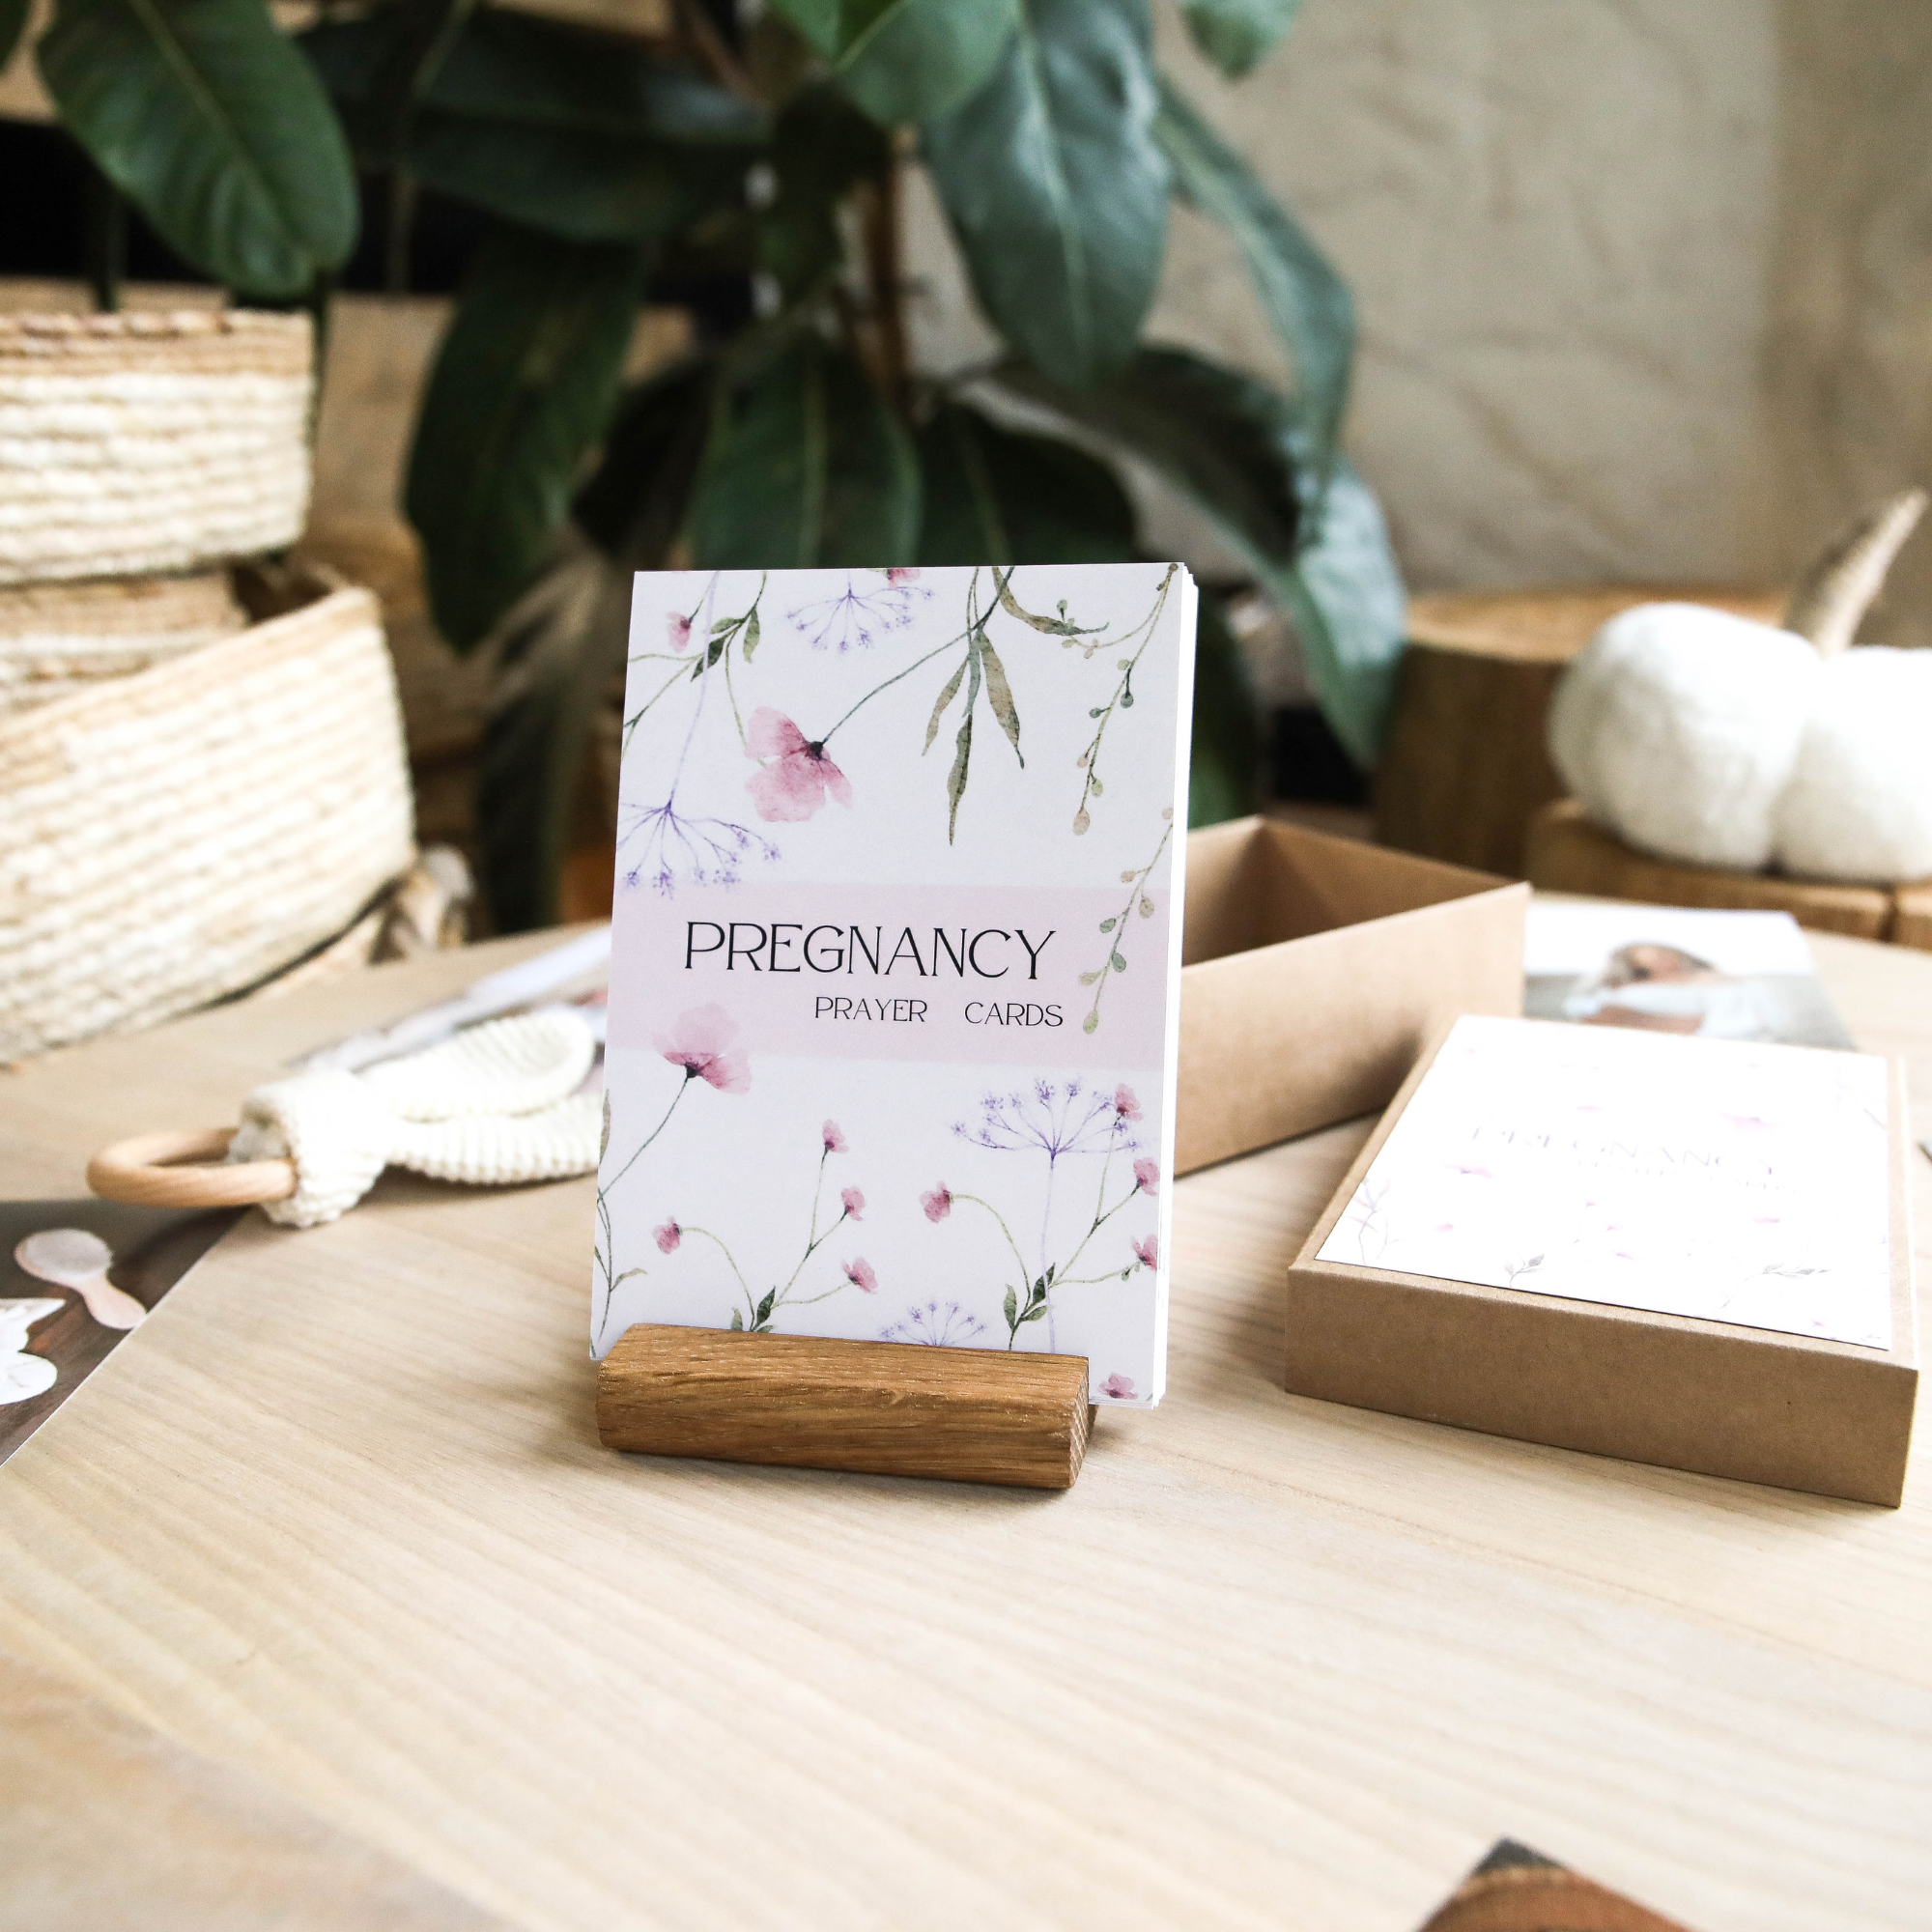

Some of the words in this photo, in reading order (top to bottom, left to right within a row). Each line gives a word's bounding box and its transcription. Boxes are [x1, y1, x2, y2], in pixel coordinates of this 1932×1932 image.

[684, 921, 1057, 980] PREGNANCY
[814, 996, 928, 1023] PRAYER
[964, 1001, 1064, 1028] CARDS
